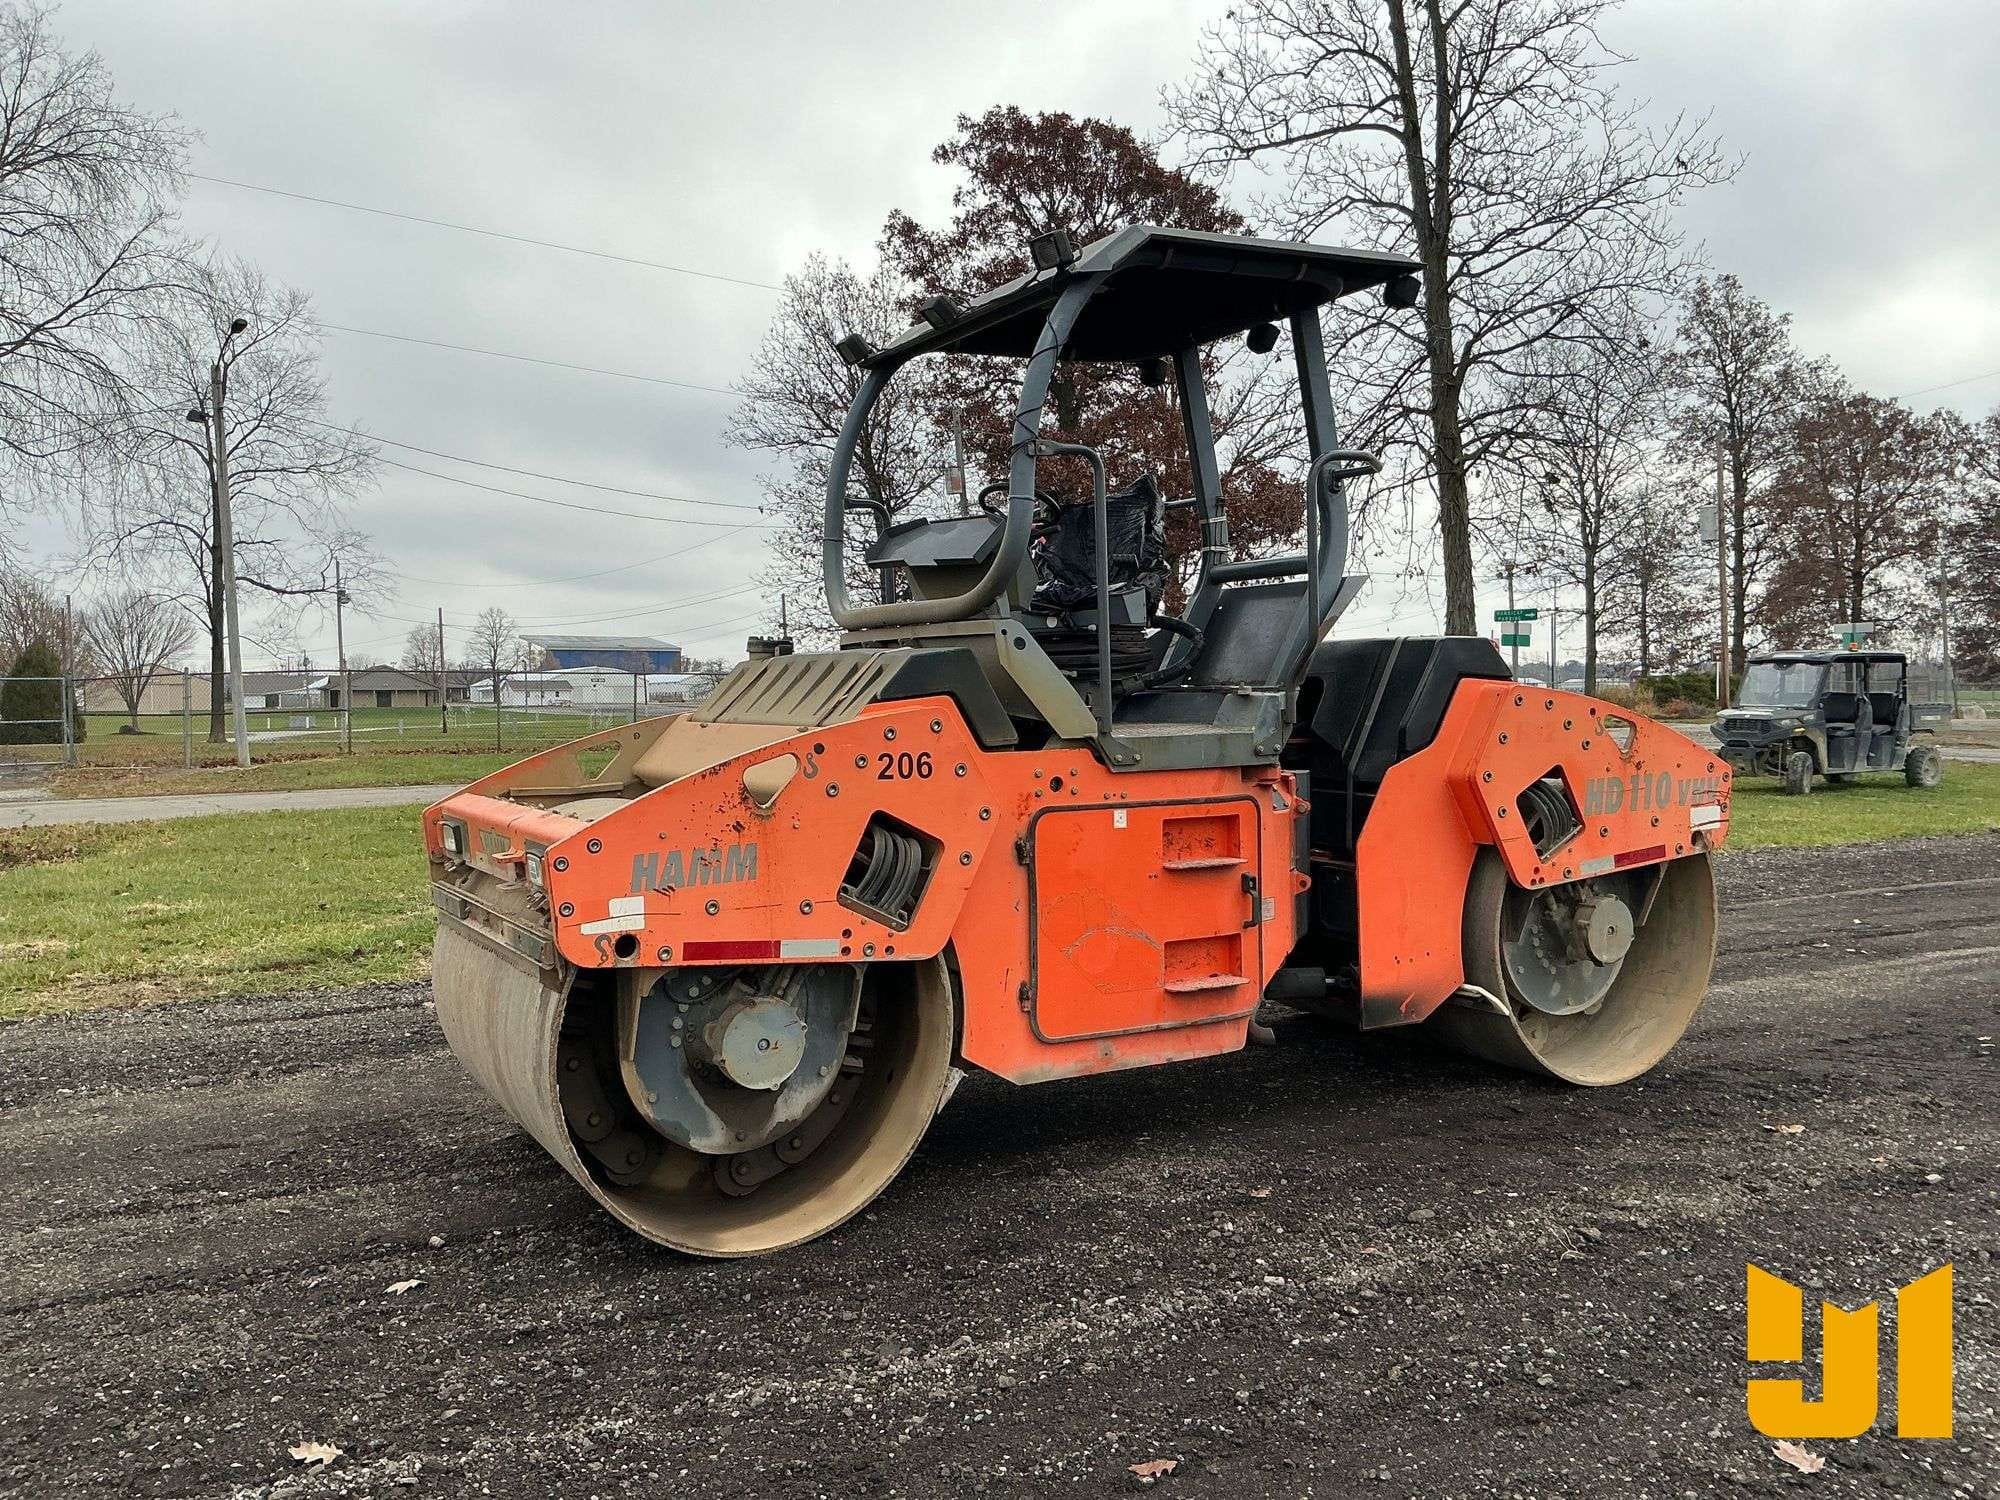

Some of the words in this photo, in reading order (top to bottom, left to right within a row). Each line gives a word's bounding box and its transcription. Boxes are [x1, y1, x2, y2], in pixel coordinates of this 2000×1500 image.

[877, 751, 933, 780] 206
[1584, 776, 1624, 816] HD
[1630, 771, 1672, 809] 110
[631, 842, 758, 893] HAMM
